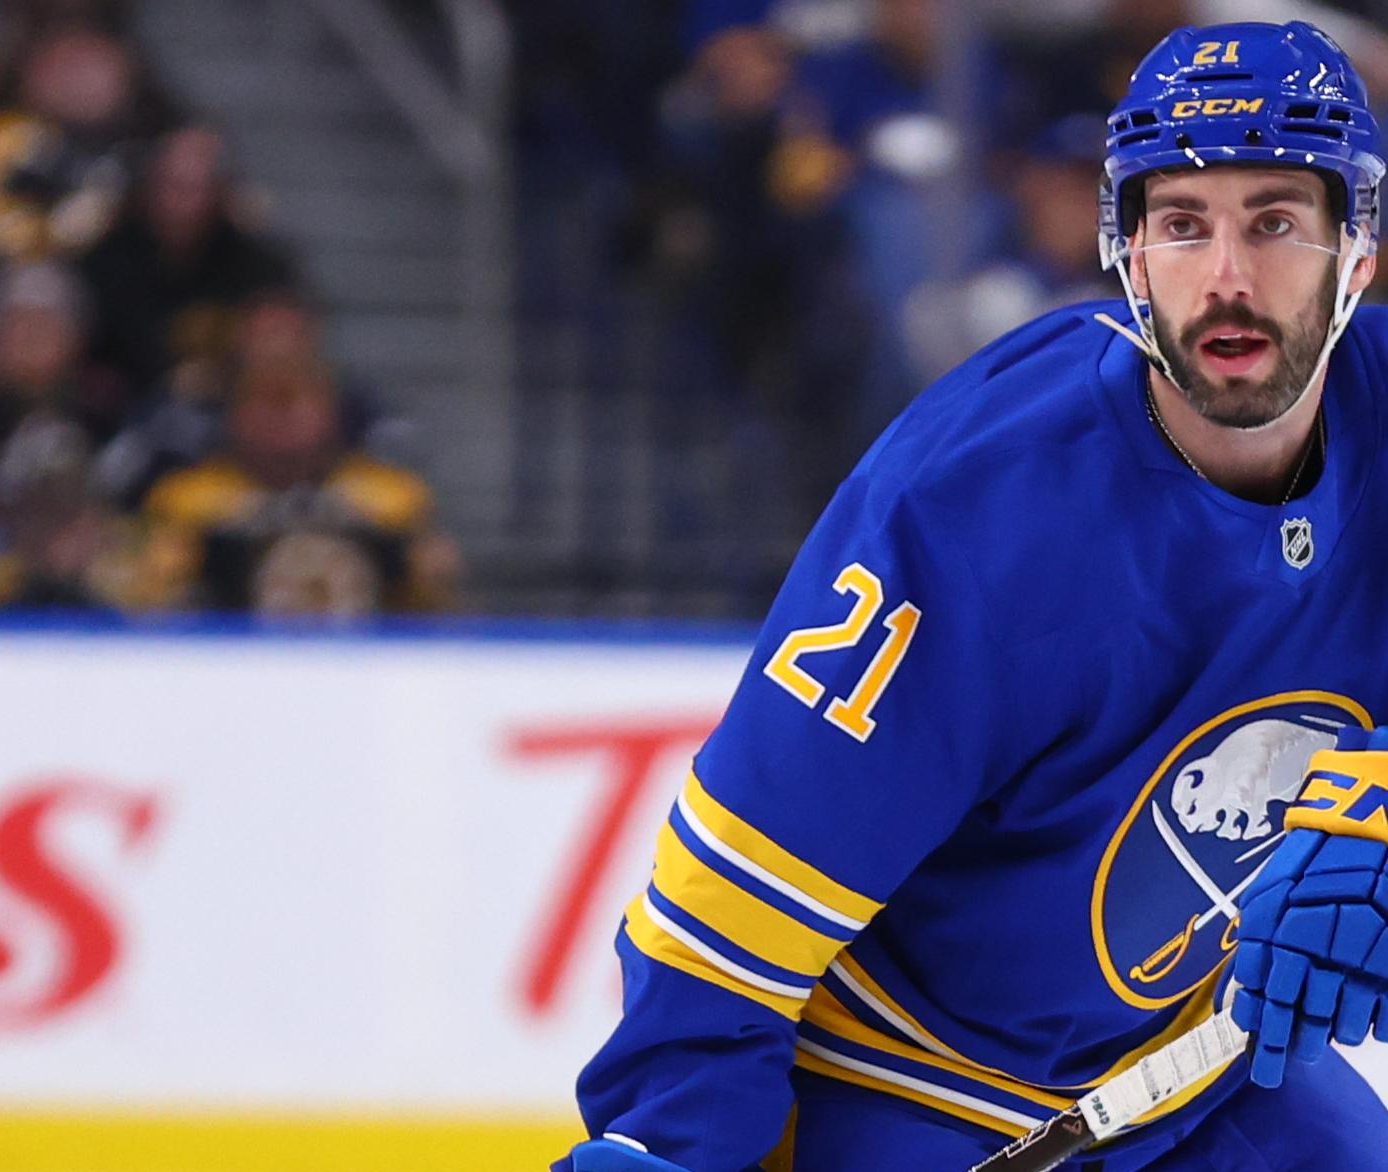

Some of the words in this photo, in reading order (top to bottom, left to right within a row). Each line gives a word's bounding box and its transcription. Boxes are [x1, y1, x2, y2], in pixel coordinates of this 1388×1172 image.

[1193, 41, 1239, 65] 21
[1172, 97, 1264, 118] CCM
[763, 562, 922, 743] 21
